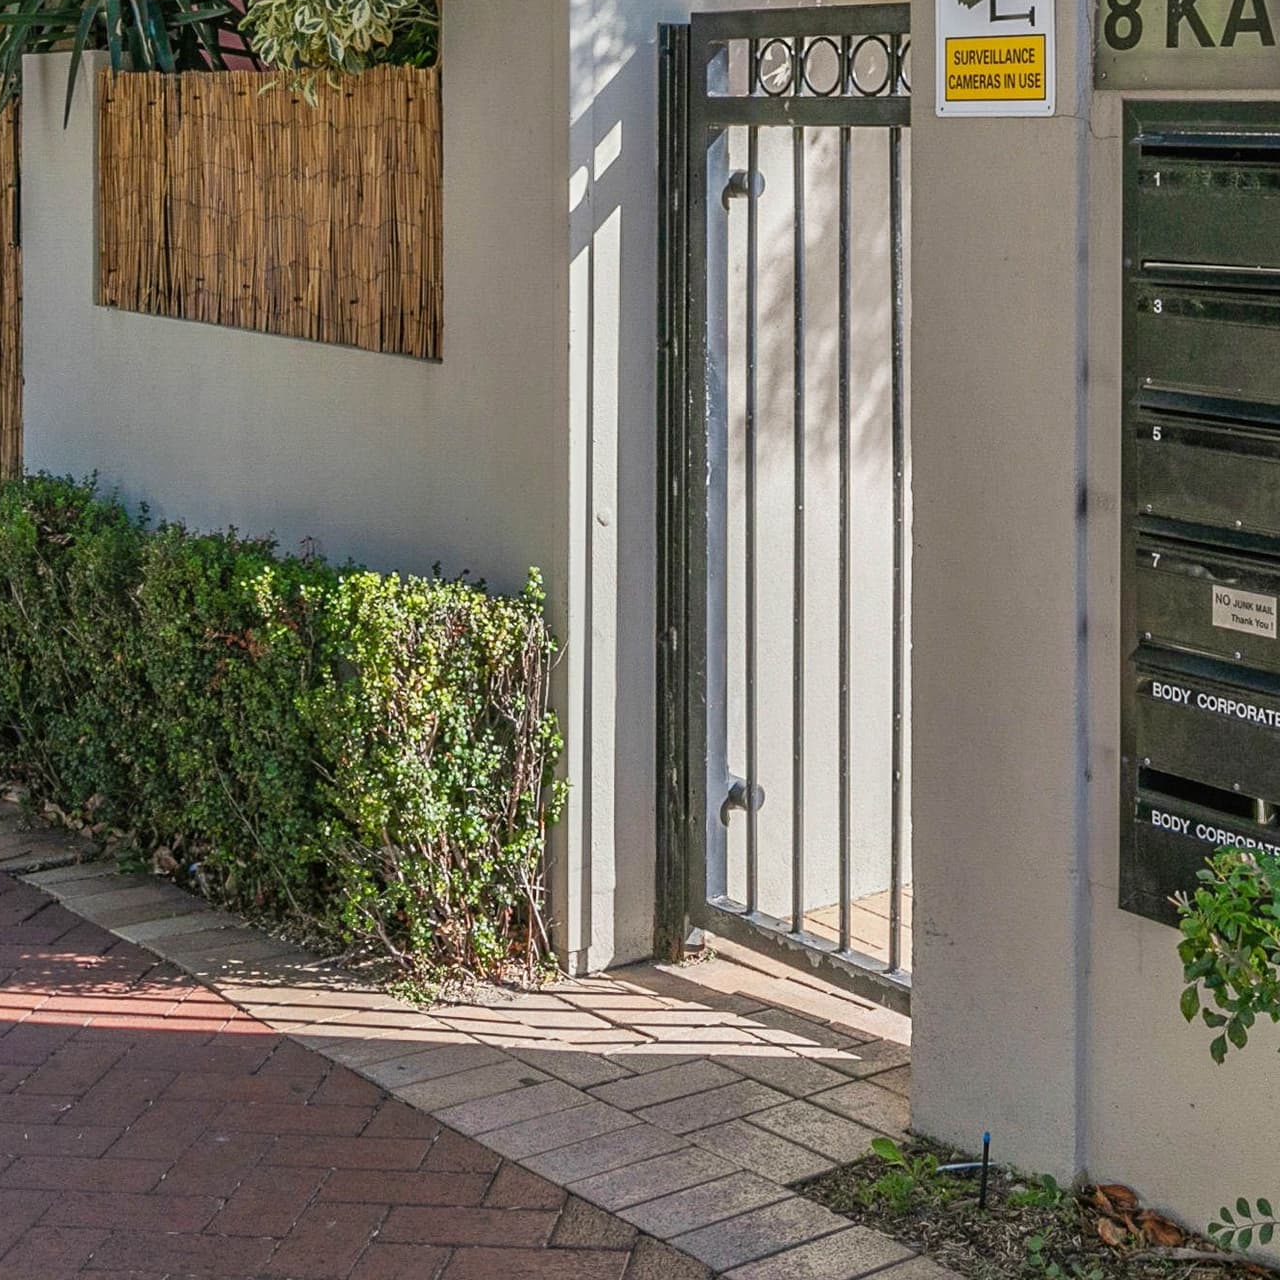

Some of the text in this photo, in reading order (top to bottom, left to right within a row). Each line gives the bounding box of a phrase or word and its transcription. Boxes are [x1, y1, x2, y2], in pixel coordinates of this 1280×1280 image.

[953, 47, 1035, 66] SURVEILLANCE
[948, 72, 1041, 90] CAMERAS IN USE
[1153, 173, 1161, 187] 1
[1153, 299, 1163, 314] 3
[1153, 426, 1162, 441] 5
[1151, 553, 1160, 567] 7
[1215, 593, 1275, 616] NO JUNK MAIL
[1231, 614, 1253, 627] Thank
[1152, 682, 1191, 704] BODY
[1151, 810, 1190, 834] BODY
